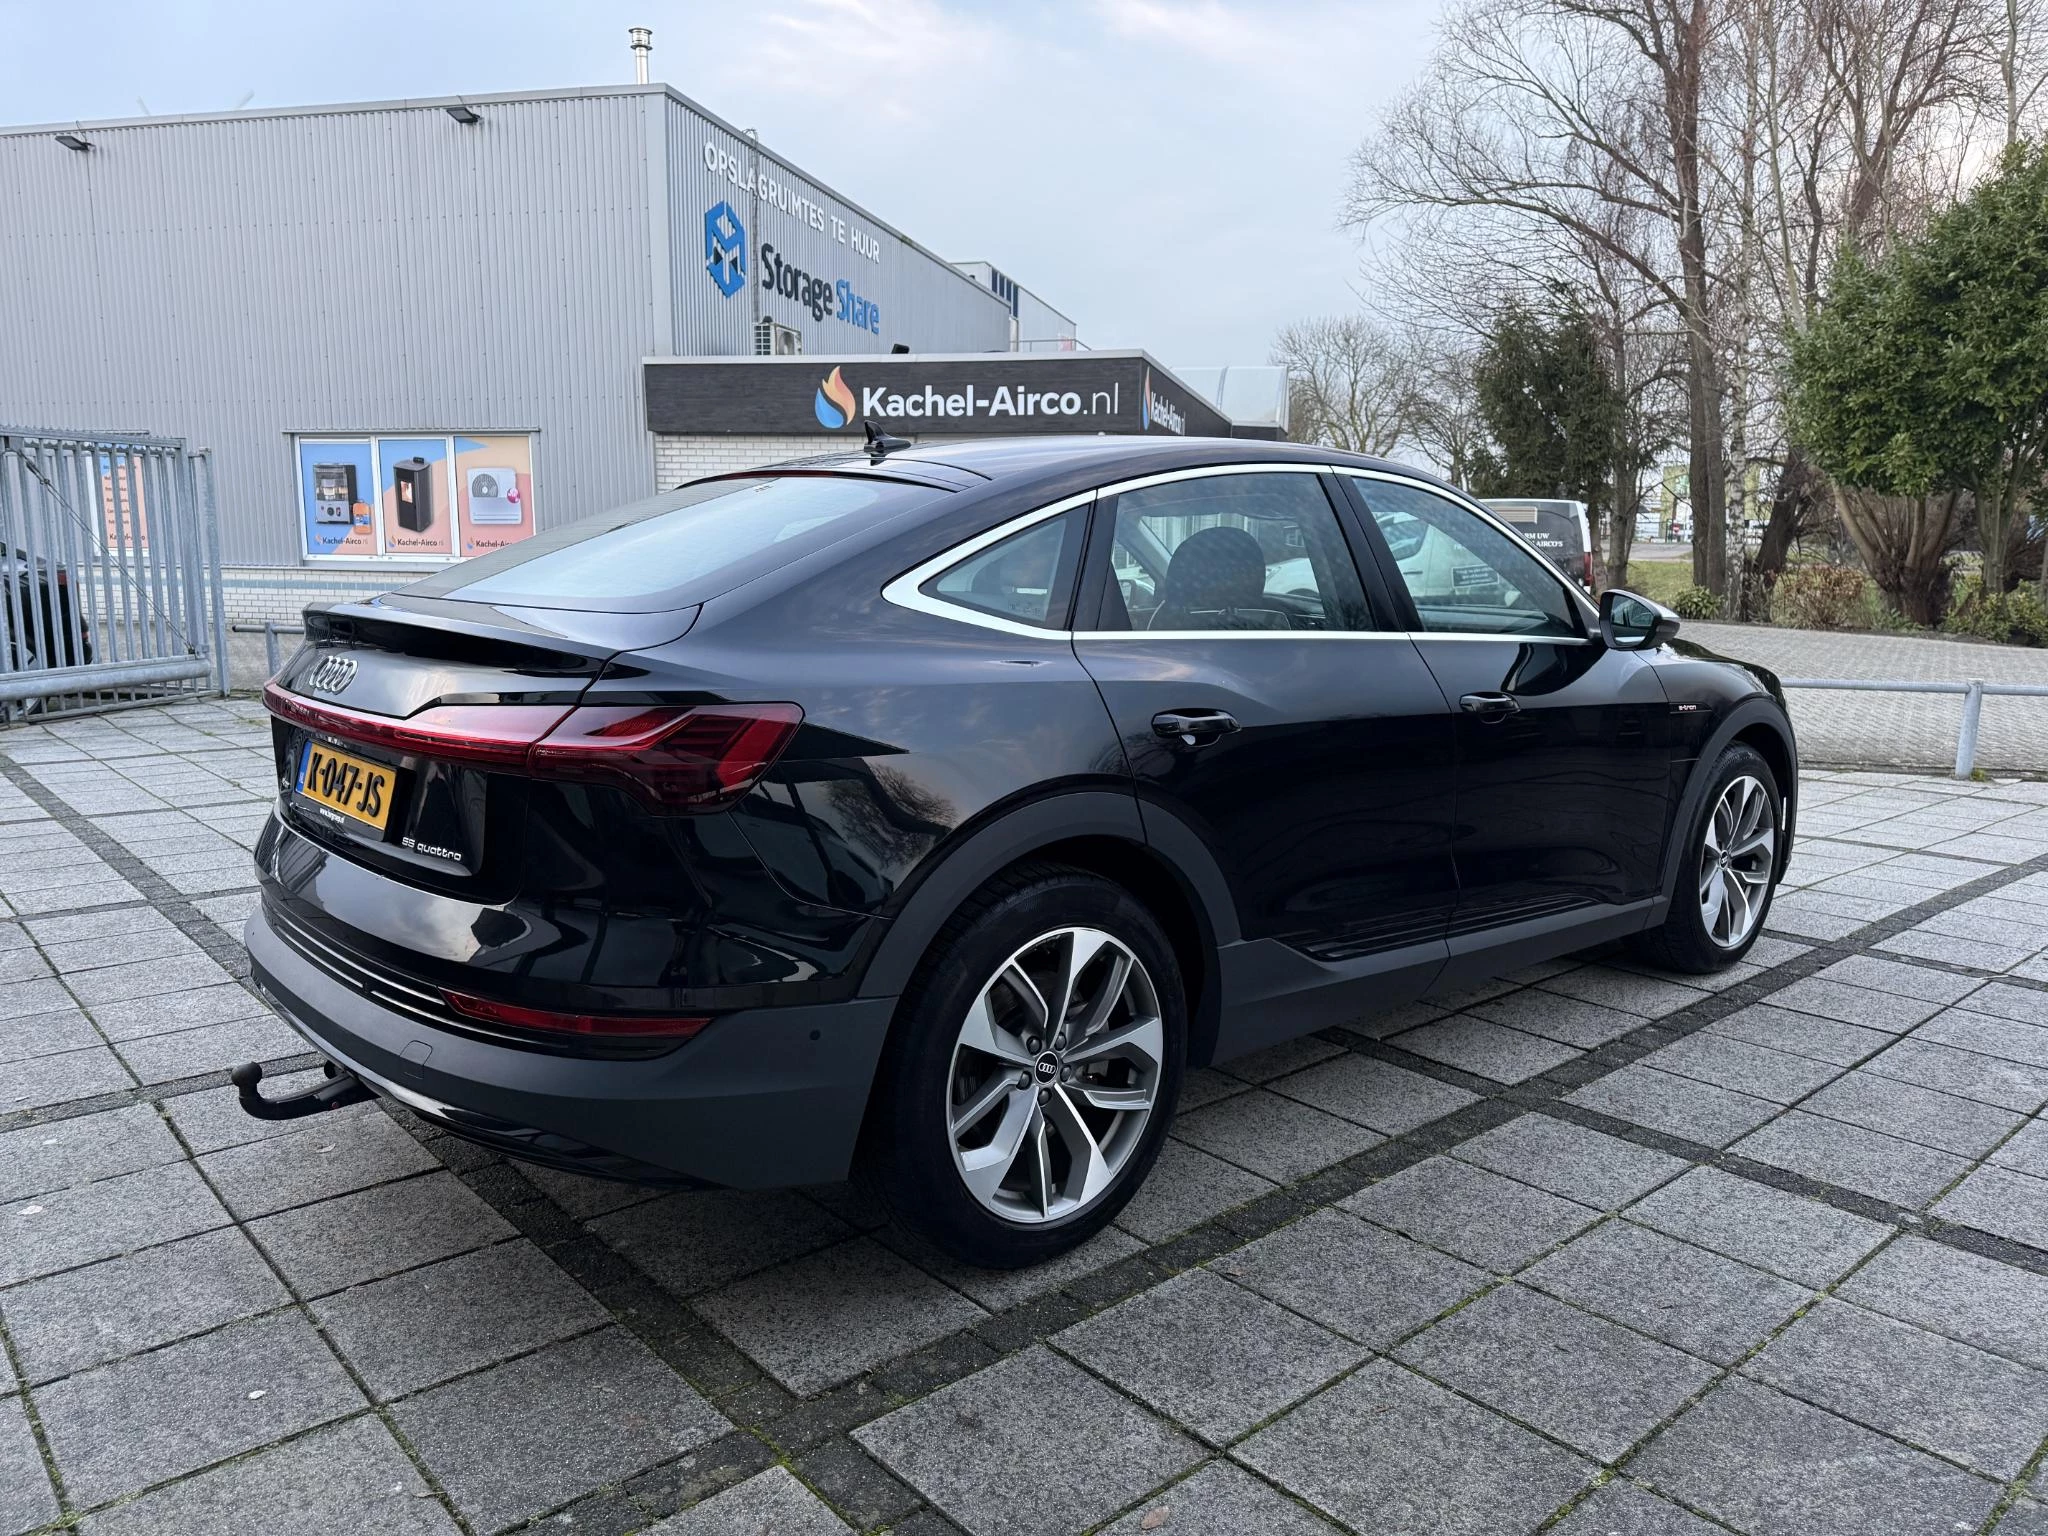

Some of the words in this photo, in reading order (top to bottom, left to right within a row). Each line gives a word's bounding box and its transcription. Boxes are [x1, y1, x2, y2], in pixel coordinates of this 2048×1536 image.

[703, 141, 825, 232] OPSLAGRUIMTES
[830, 216, 846, 244] TE
[851, 227, 880, 264] HUUR
[761, 243, 833, 322] Storage
[835, 279, 880, 335] Share
[862, 382, 1119, 417] Kachel-Airco.nl
[1150, 391, 1186, 436] Kachel-Airco.nl
[307, 752, 385, 818] K-047-JS
[402, 836, 416, 848] 55
[417, 843, 462, 862] quattro
